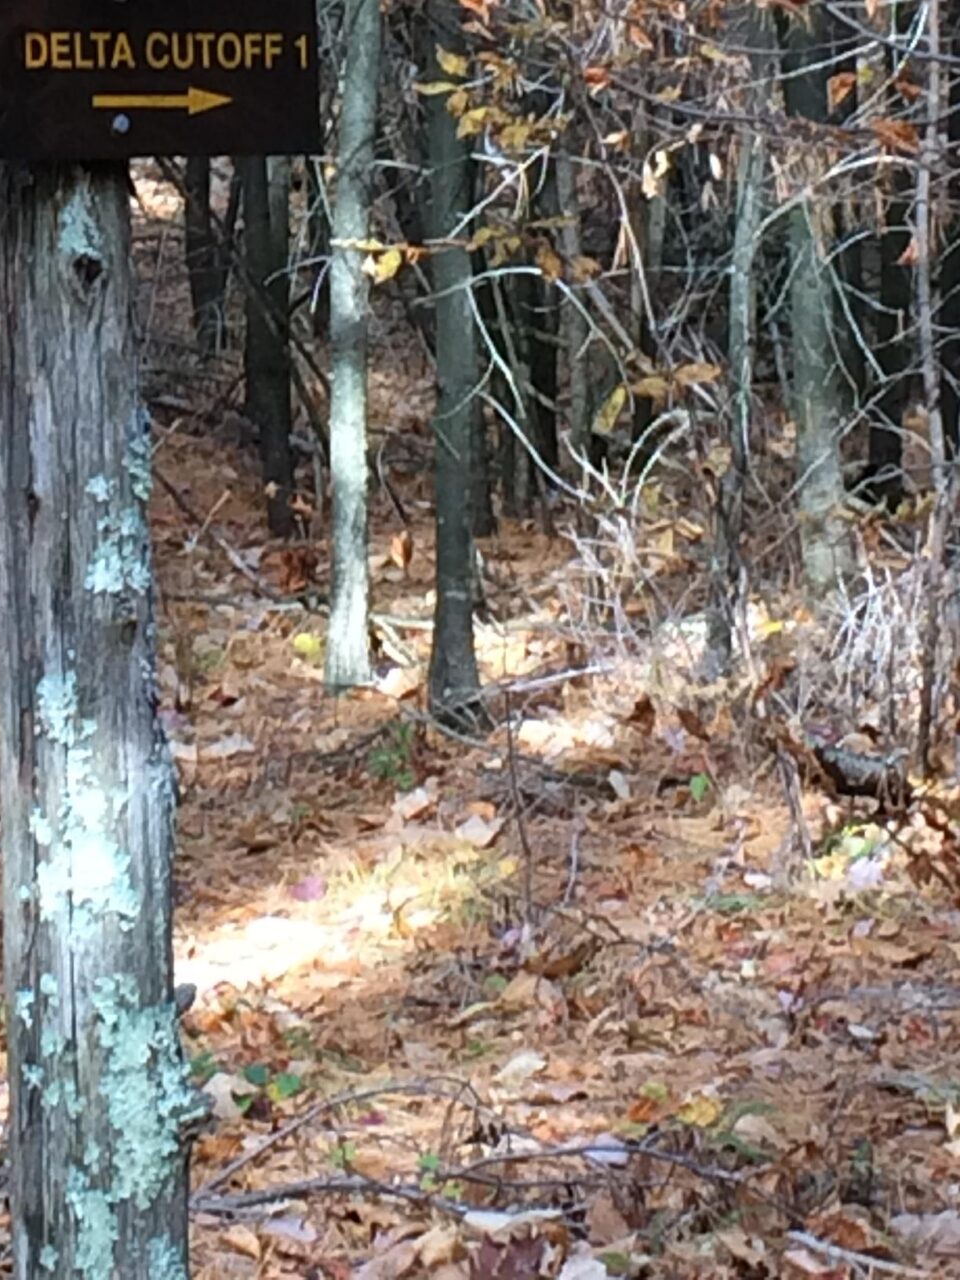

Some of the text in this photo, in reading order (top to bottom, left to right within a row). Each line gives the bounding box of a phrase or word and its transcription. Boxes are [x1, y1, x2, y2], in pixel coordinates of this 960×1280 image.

[24, 31, 309, 69] DELTA CUTOFF 1
